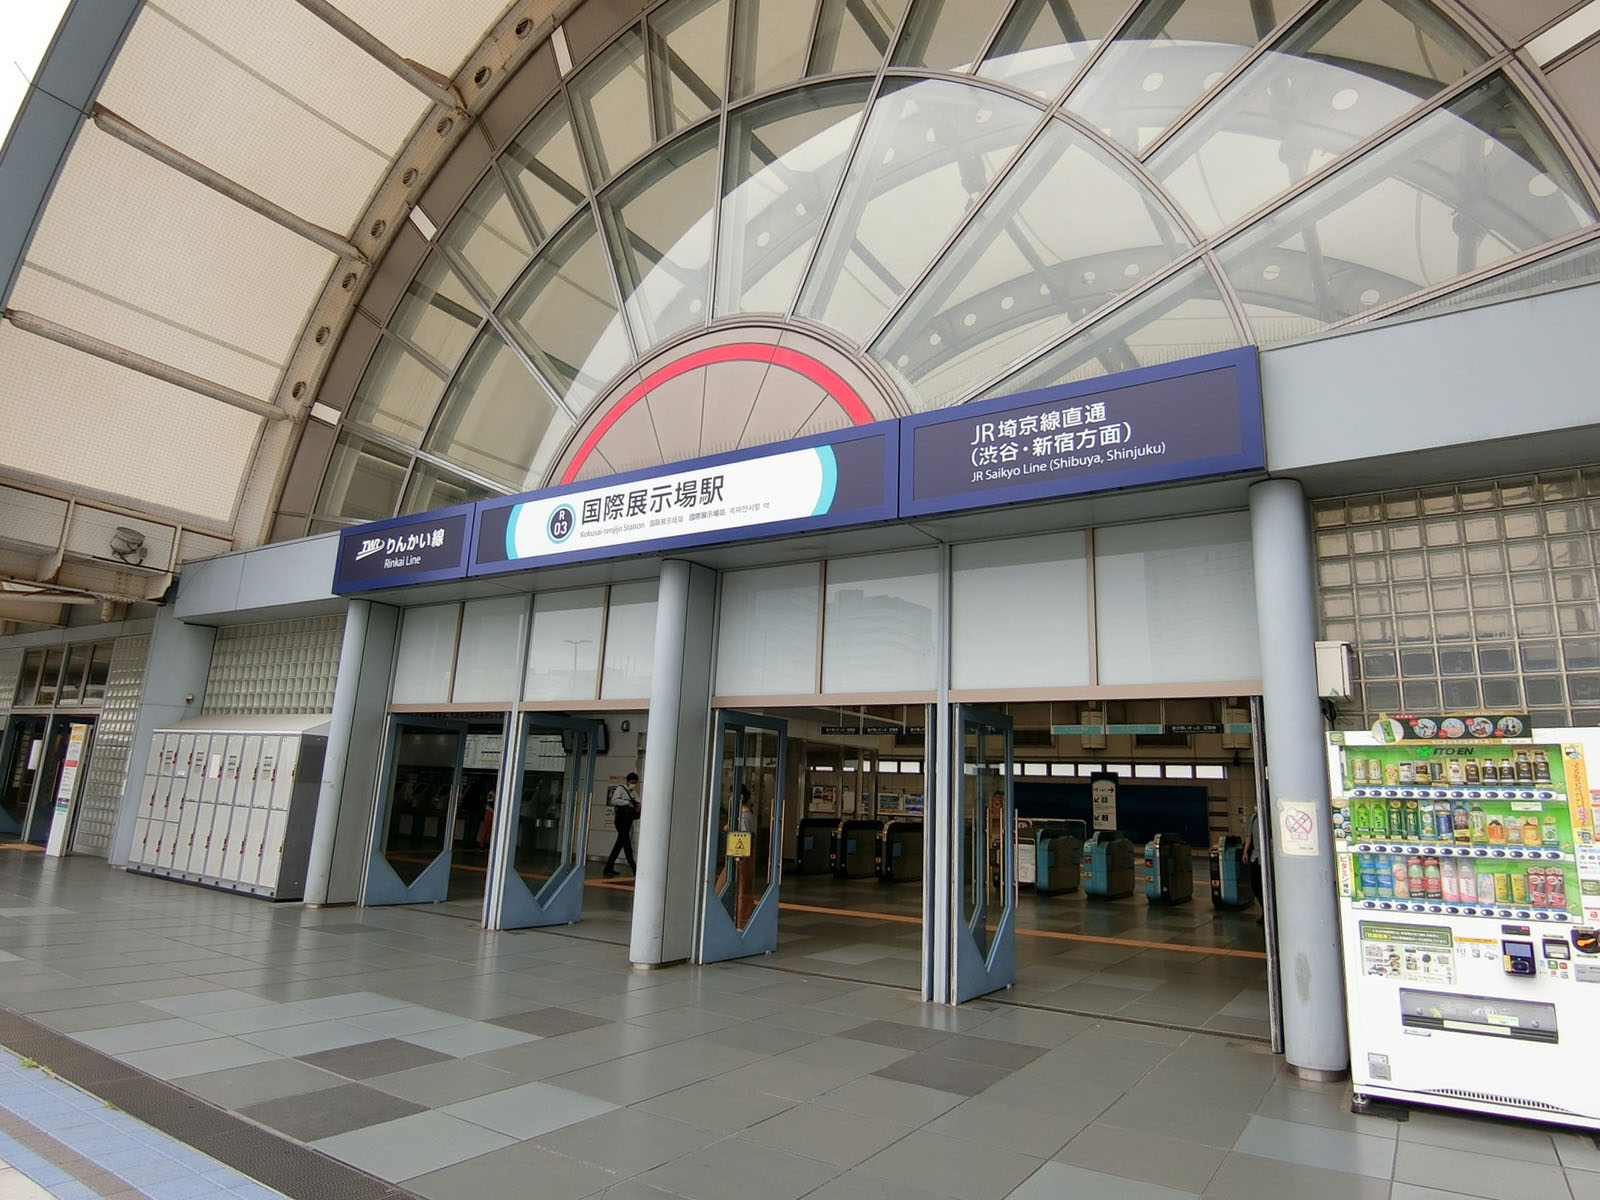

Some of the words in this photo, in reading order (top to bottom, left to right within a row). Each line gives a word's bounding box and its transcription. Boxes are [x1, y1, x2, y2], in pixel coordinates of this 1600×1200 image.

[970, 401, 1107, 446] JR埼京線直通
[970, 470, 983, 483] JR
[985, 466, 1021, 481] Saikyo
[1023, 462, 1047, 475] Line
[1049, 451, 1104, 473] (Shibuya,
[1106, 441, 1166, 461] Shinjuku)
[581, 474, 725, 525] 国際展示場駅
[559, 510, 566, 520] R
[553, 521, 568, 535] 03
[580, 525, 623, 538] Kokusai-tenjijo
[623, 523, 645, 532] Station
[357, 538, 385, 558] TWR
[386, 528, 445, 554] りんかい線
[384, 556, 405, 569] Rinkai
[405, 555, 421, 567] Line
[1433, 748, 1455, 756] ITO
[1456, 747, 1474, 755] EN
